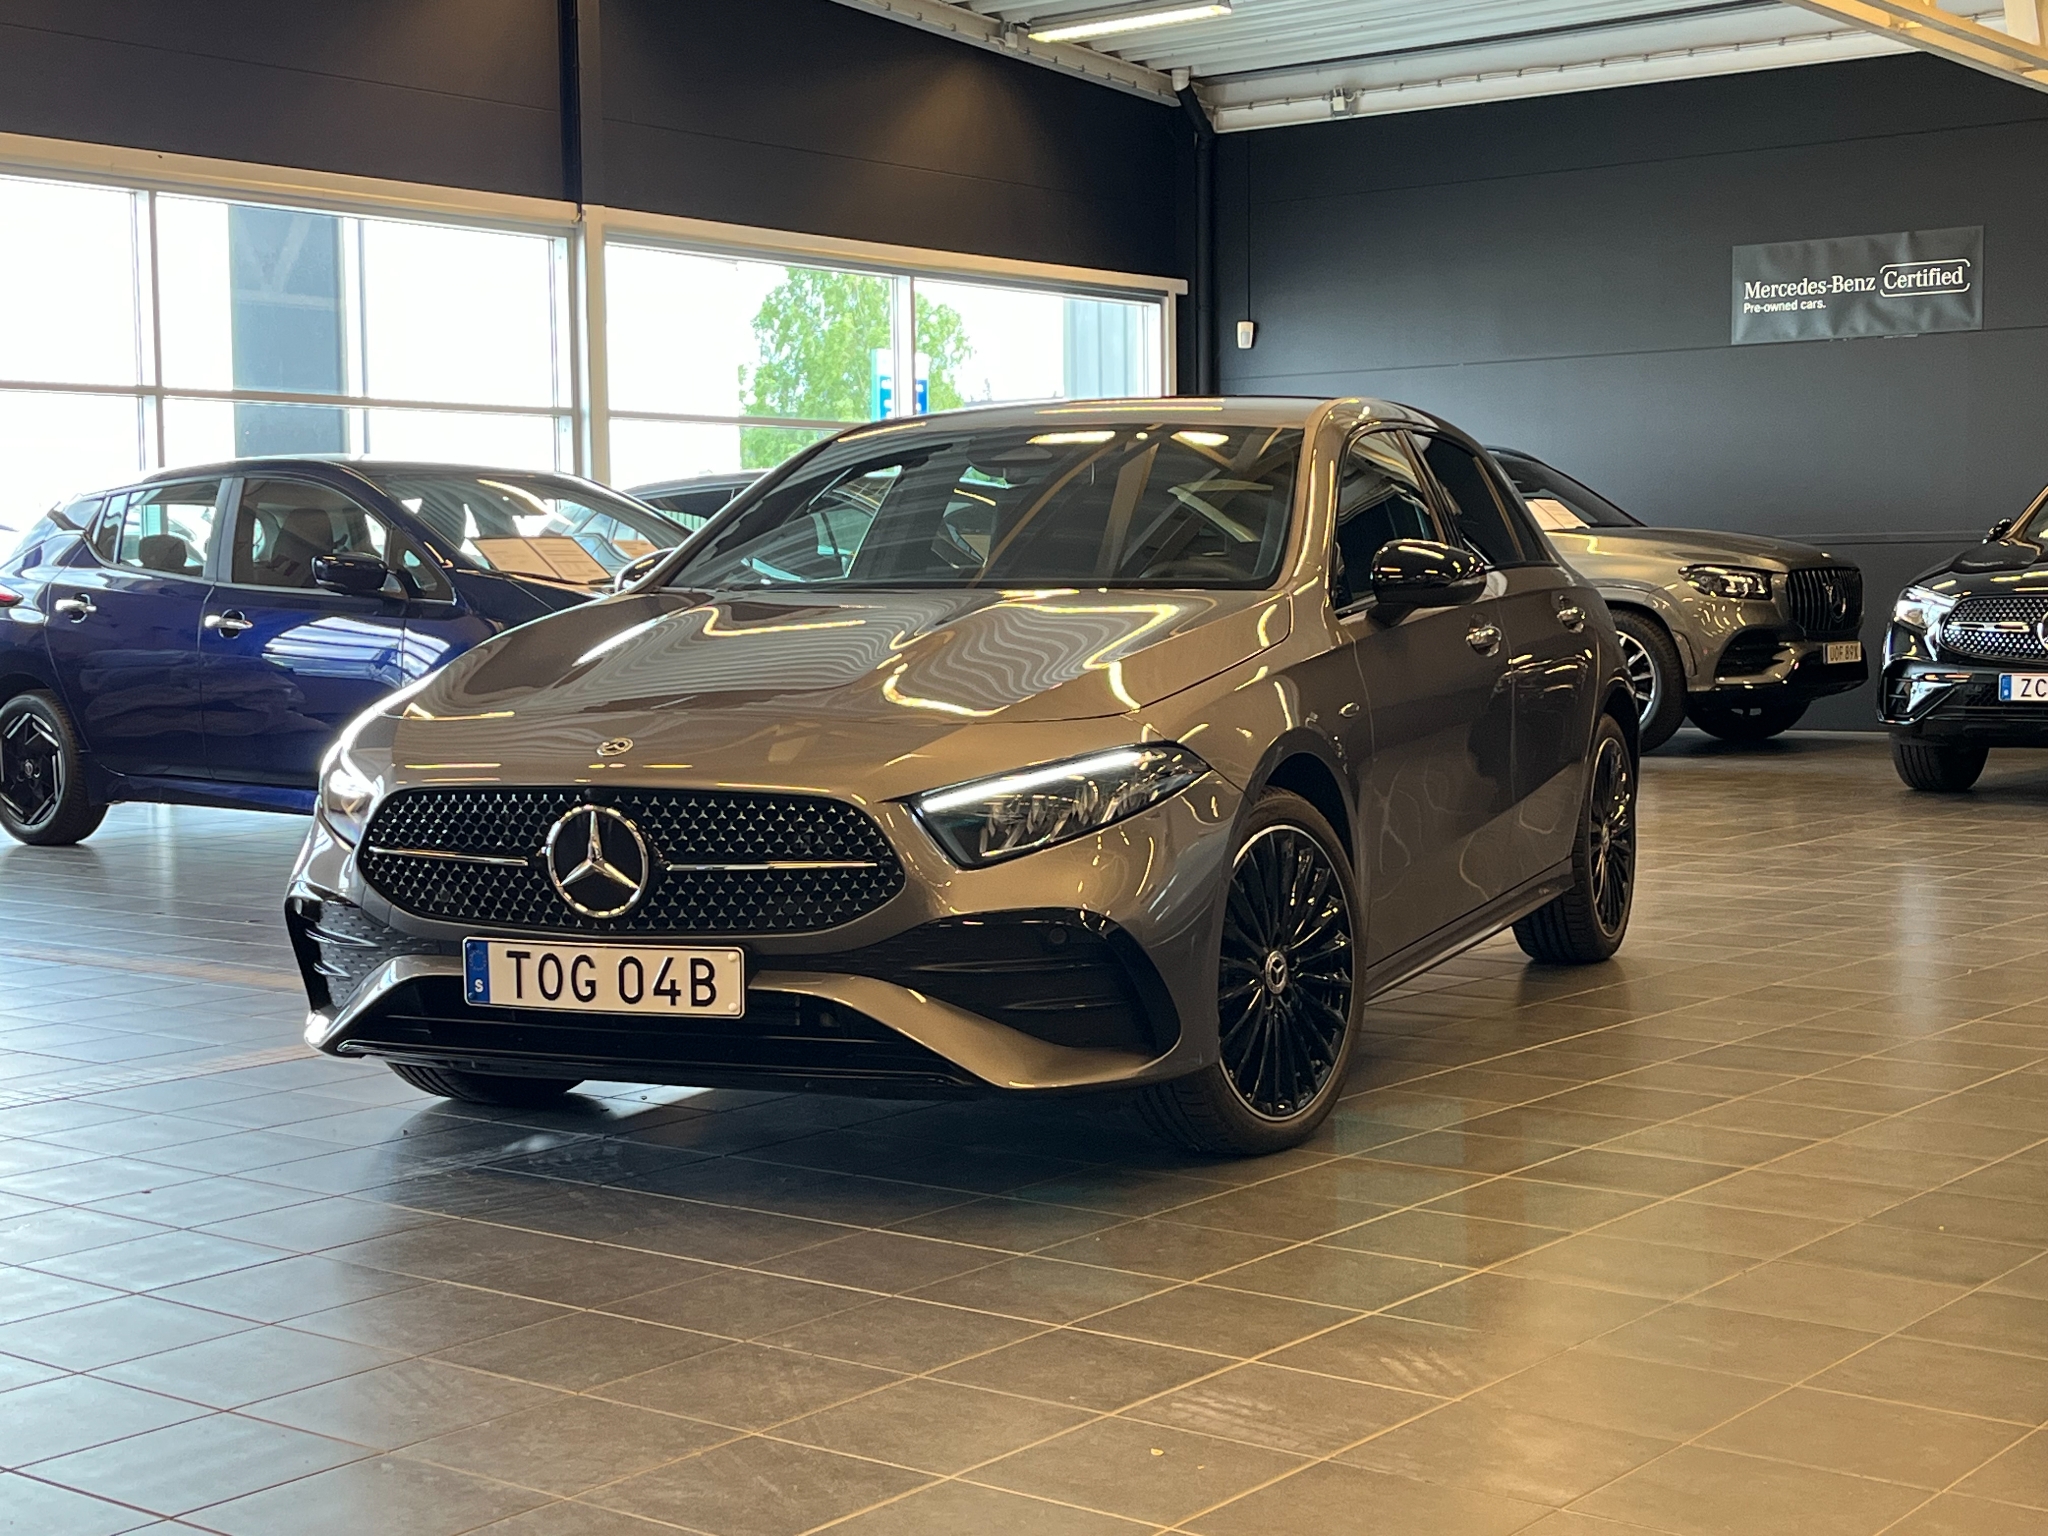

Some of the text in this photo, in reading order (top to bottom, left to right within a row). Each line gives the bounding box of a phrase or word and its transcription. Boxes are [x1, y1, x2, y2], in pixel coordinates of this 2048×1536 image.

[1743, 266, 1964, 300] Mercedes-Benz Certified
[1743, 300, 1827, 314] Pre-owned cars.
[474, 978, 484, 993] S
[506, 950, 717, 1007] TOG 04B
